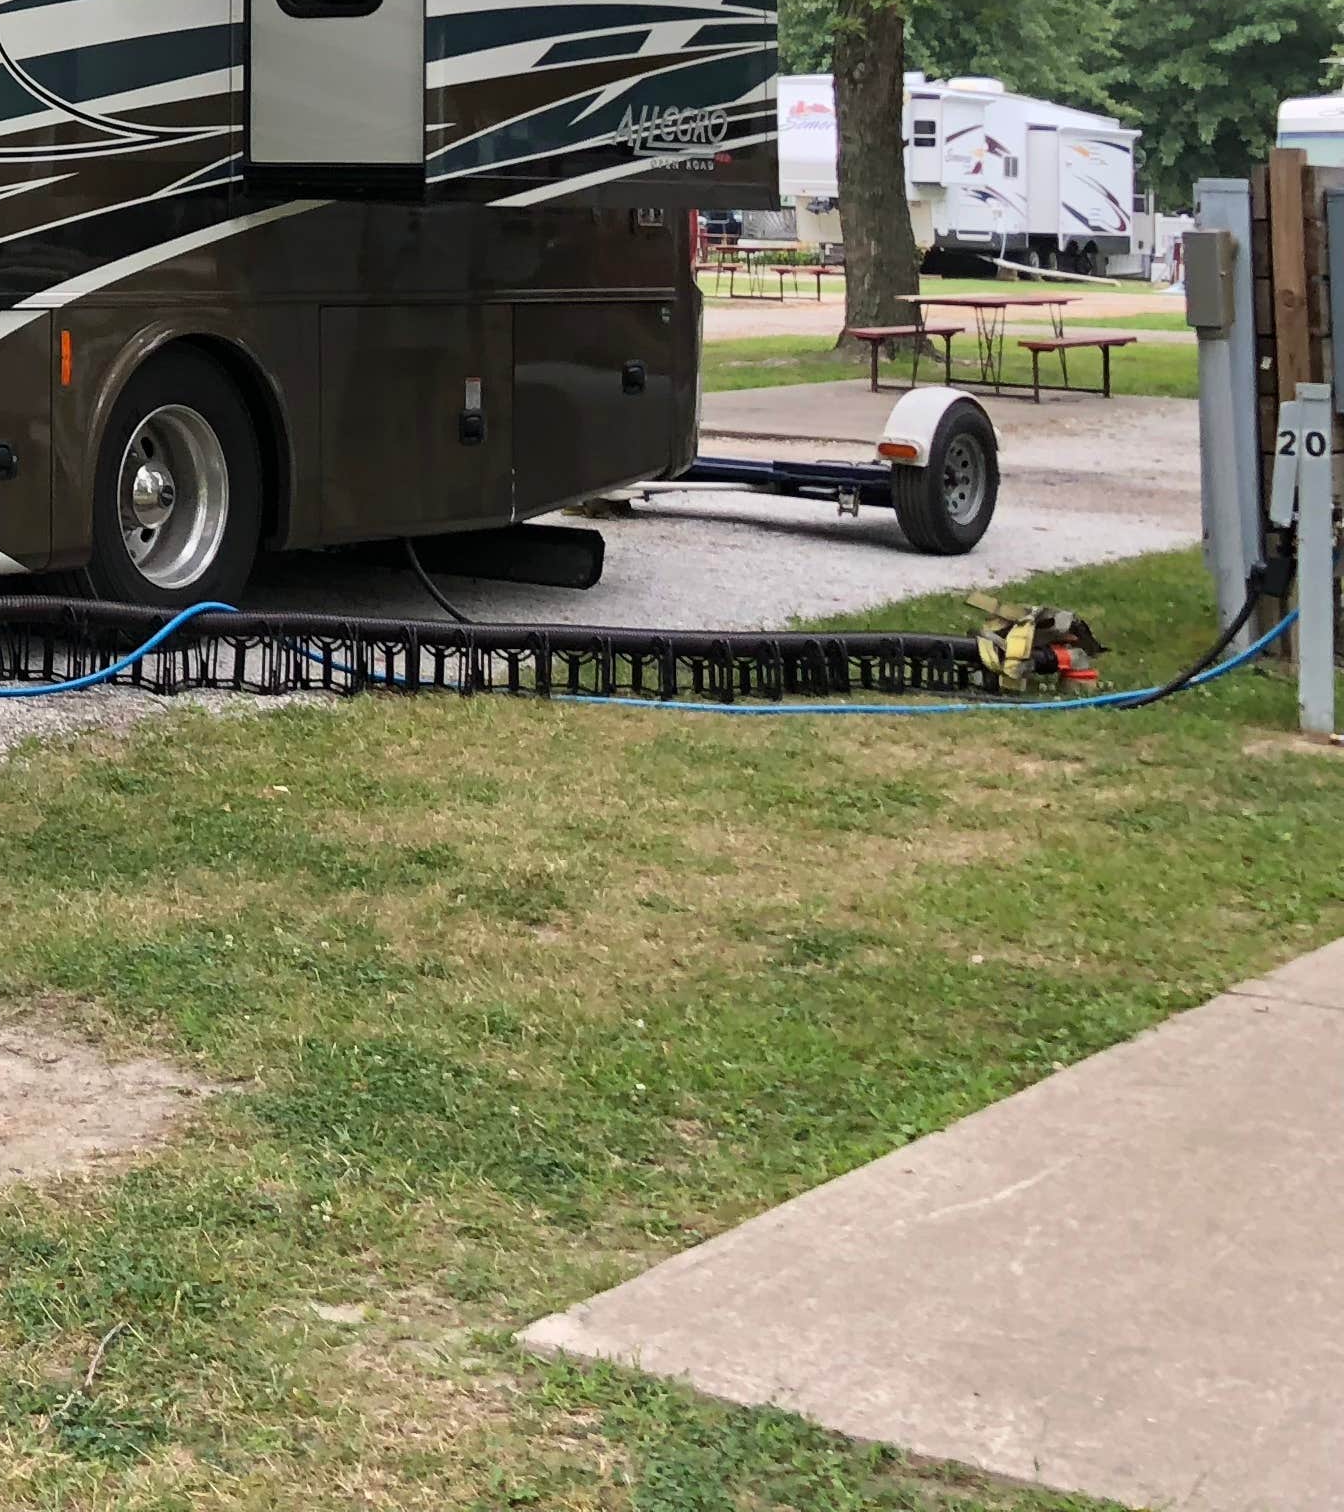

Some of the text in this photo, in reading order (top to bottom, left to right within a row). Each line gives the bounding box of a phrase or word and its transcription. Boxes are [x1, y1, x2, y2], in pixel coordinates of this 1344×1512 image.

[613, 103, 728, 159] ALLEGRO
[685, 159, 714, 171] ROAD
[1278, 430, 1327, 457] 20
